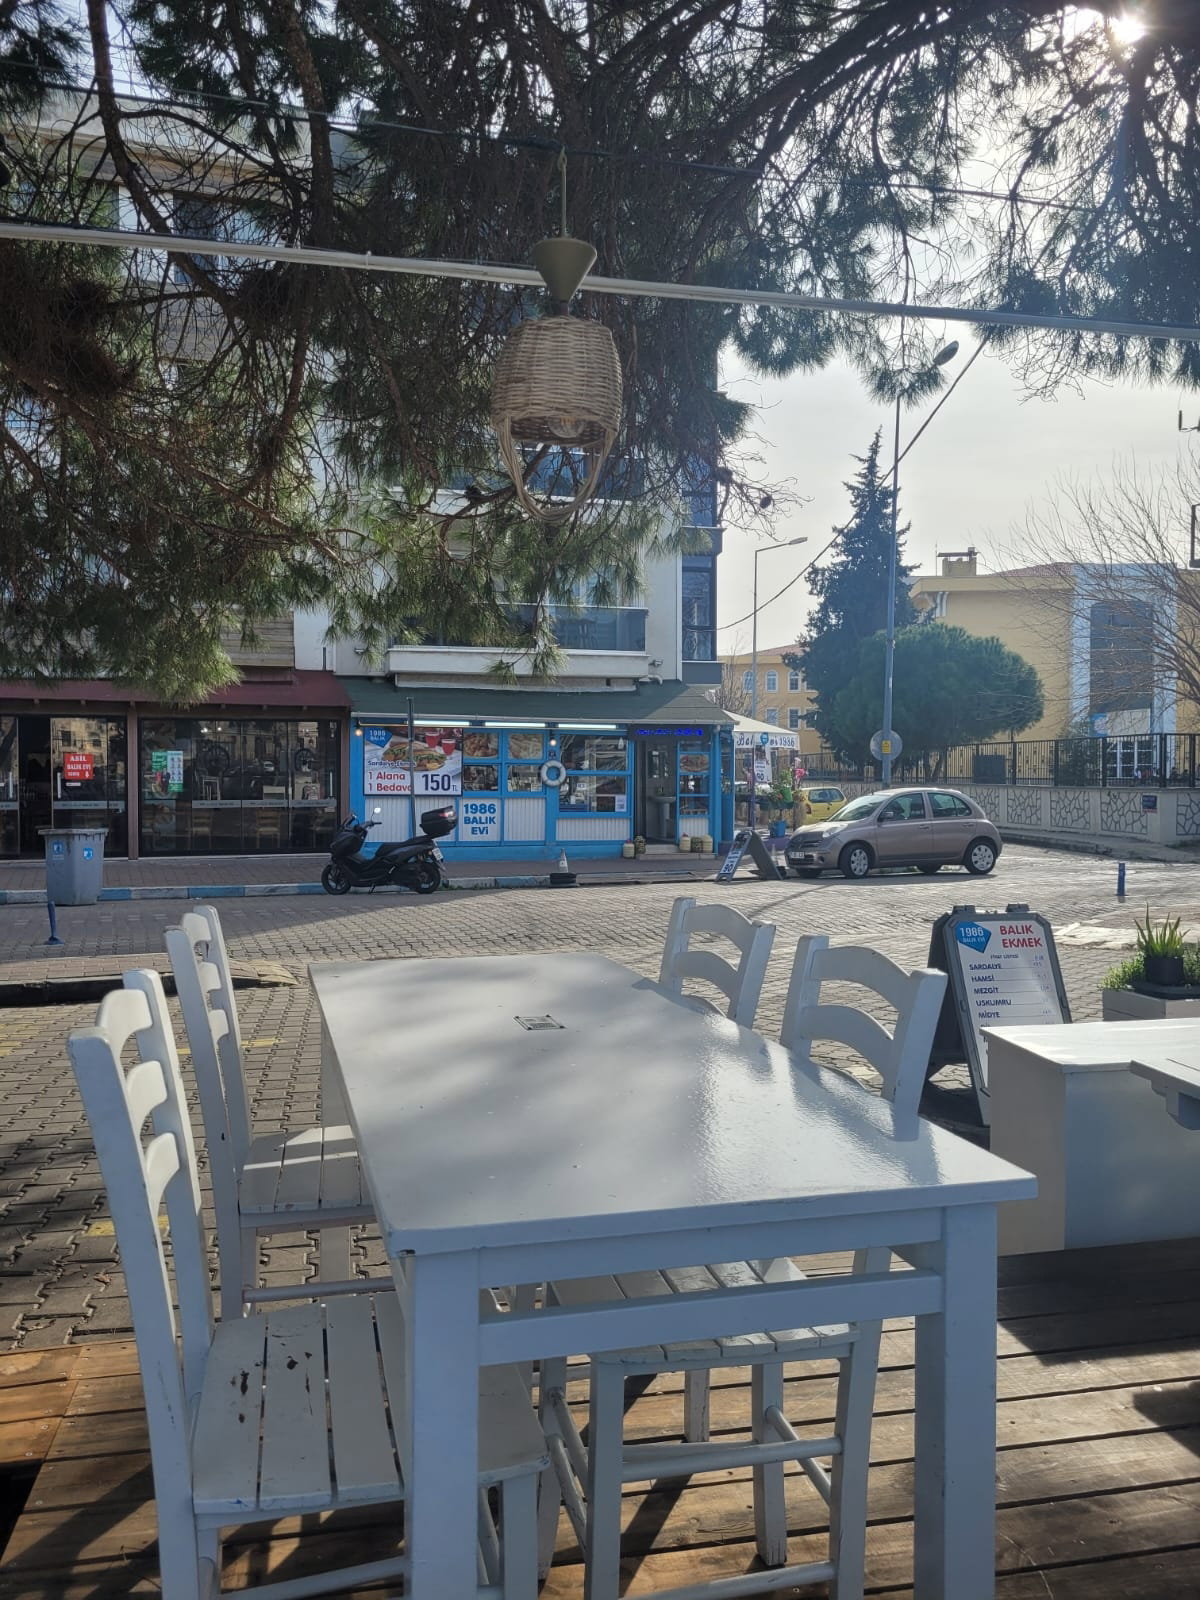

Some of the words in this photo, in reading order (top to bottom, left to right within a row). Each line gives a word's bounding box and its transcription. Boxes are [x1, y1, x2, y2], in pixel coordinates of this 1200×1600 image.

[368, 771, 373, 780] 1
[376, 771, 406, 780] Alana
[368, 783, 373, 791] 1
[422, 774, 451, 791] 150
[464, 803, 496, 814] 1986
[464, 816, 496, 824] BALIK
[960, 927, 984, 937] 1986
[1000, 924, 1034, 935] BALIK
[1002, 937, 1043, 948] EKMEK
[969, 962, 1002, 971] SARDALYE
[976, 999, 1012, 1007] USKUMRU
